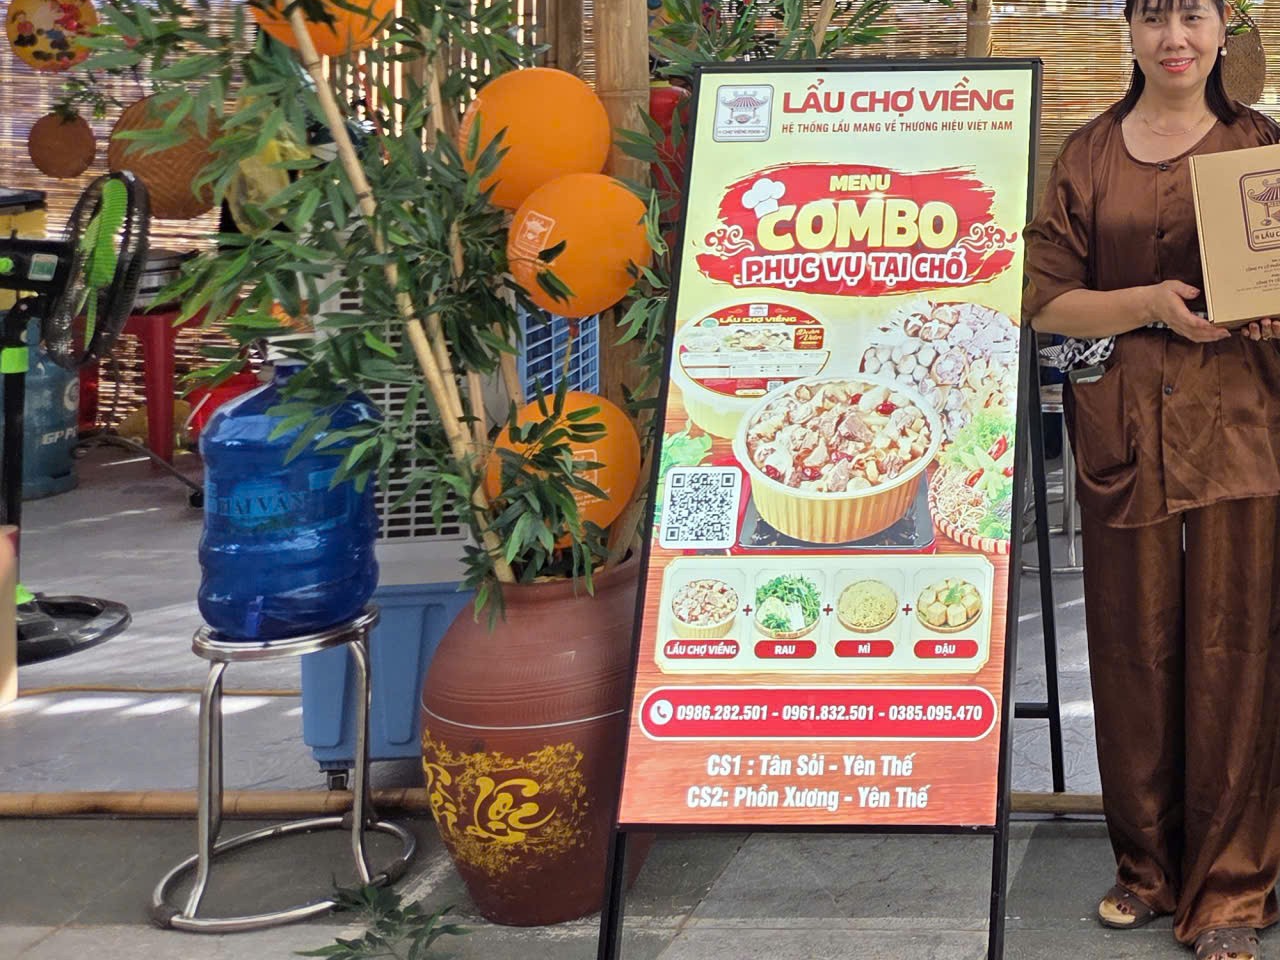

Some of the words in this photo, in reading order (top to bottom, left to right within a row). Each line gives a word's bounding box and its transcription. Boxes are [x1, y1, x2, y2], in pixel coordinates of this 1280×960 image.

[782, 78, 845, 113] LẨU
[850, 86, 915, 117] CHỢ
[918, 76, 1014, 112] VIỀNG
[781, 120, 795, 134] HỆ
[797, 118, 829, 133] THỐNG
[832, 119, 850, 133] LẨU
[853, 122, 881, 132] MANG
[884, 119, 897, 132] VỀ
[900, 120, 938, 132] THƯƠNG
[941, 118, 964, 133] HIỆU
[967, 118, 988, 133] VIỆT
[991, 120, 1013, 131] NAM
[829, 174, 891, 192] MENU
[756, 198, 959, 252] COMBO
[742, 254, 820, 287] PHỤC
[824, 253, 865, 286] VỤ
[870, 254, 910, 285] TẠI
[913, 249, 967, 282] CHỖ
[666, 641, 686, 655] LẨU
[687, 643, 707, 657] CHỢ
[707, 641, 737, 655] VIỀNG
[774, 645, 796, 655] RAU
[857, 642, 871, 654] MÌ
[934, 643, 956, 657] ĐẬU
[676, 704, 768, 721] 0986.282.501
[782, 704, 874, 721] 0961.832.501
[888, 704, 983, 721] 0385.095.470
[707, 753, 742, 776] CS1
[758, 754, 792, 776] Tân
[796, 752, 824, 776] Sỏi
[843, 754, 876, 776] Yên
[881, 752, 917, 776] Thế
[687, 786, 728, 808] CS2:
[733, 784, 779, 808] Phồn
[783, 786, 840, 811] Xương
[857, 785, 890, 808] Yên
[896, 784, 932, 808] Thế
